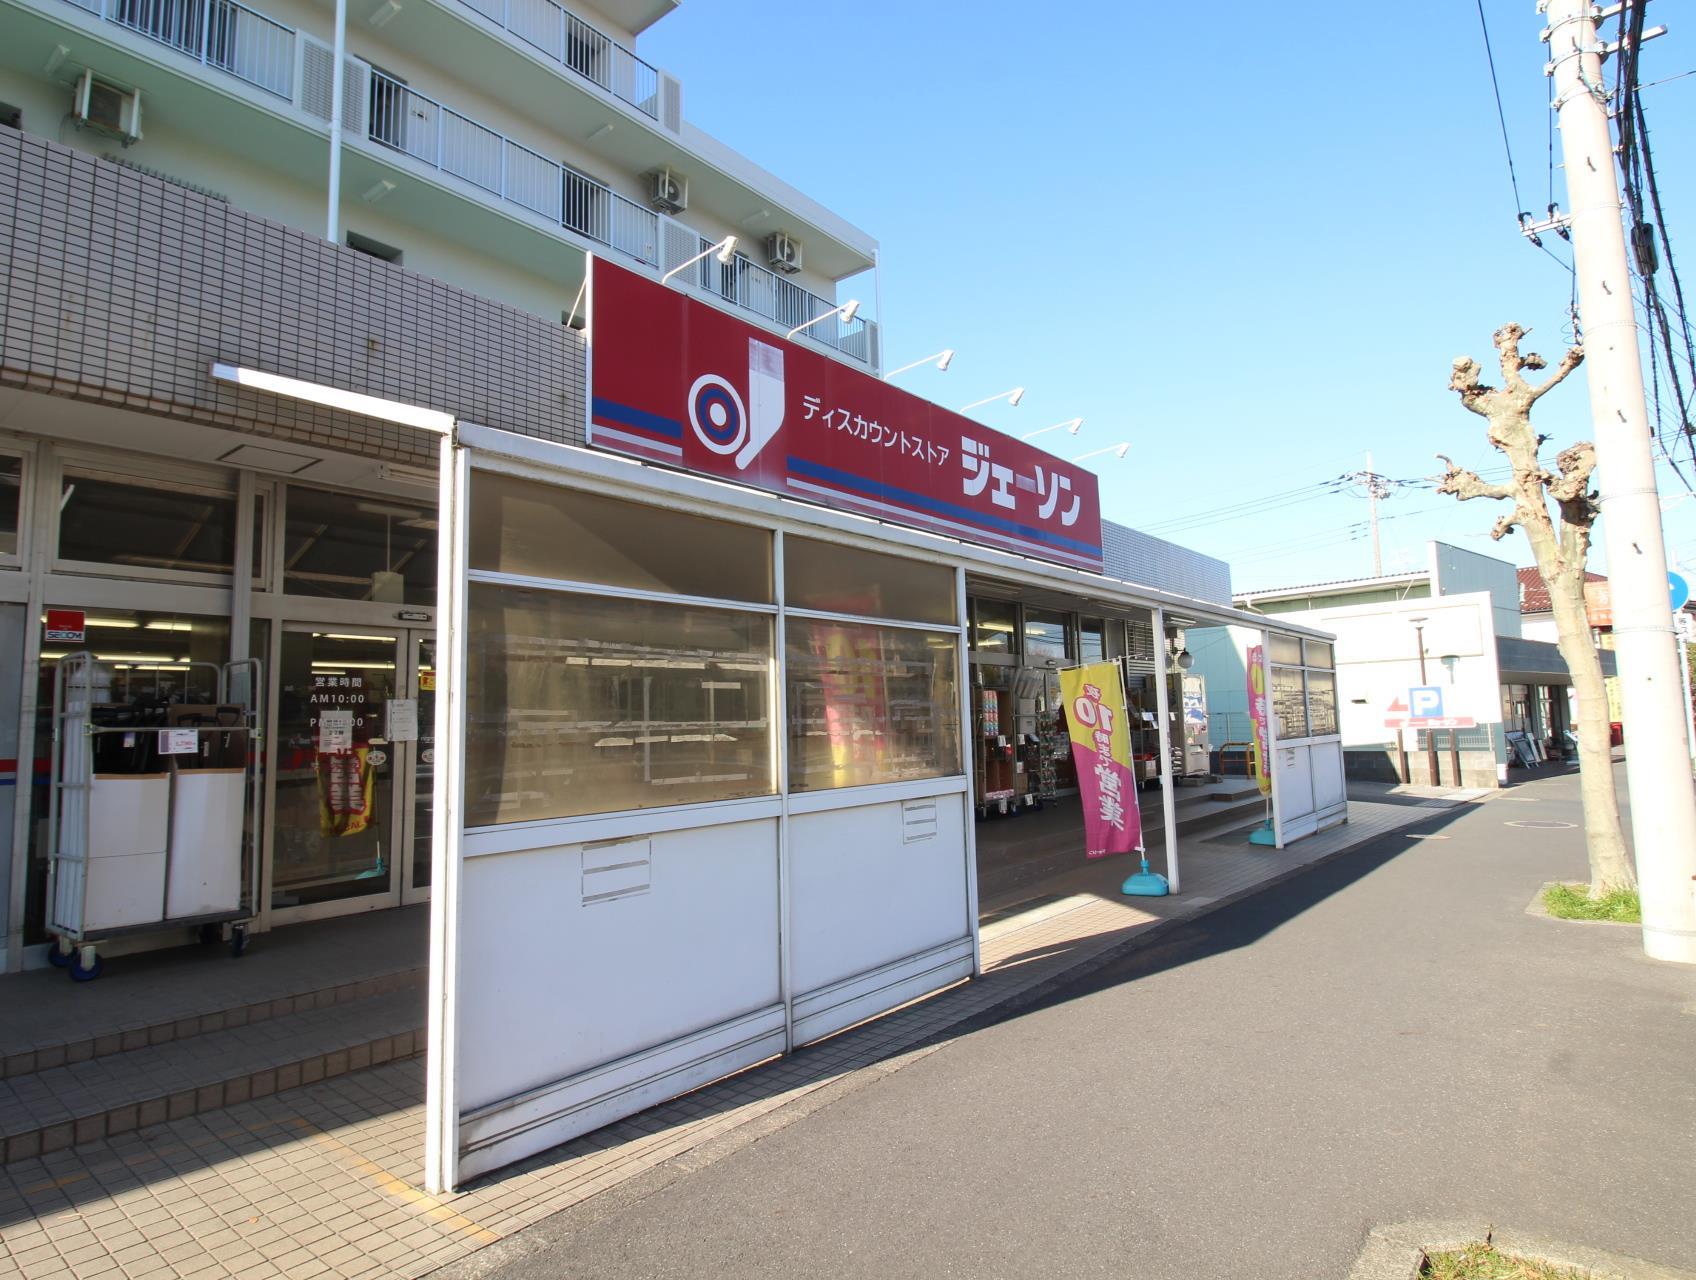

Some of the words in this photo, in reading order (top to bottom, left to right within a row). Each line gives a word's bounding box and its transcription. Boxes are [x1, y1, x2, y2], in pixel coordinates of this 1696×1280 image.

[802, 394, 950, 466] ディスカウントストア
[960, 435, 1081, 526] ジェーソン
[47, 631, 82, 639] SECOM
[315, 677, 362, 688] 営業時間
[310, 694, 365, 703] AM10:00
[1413, 690, 1439, 716] P
